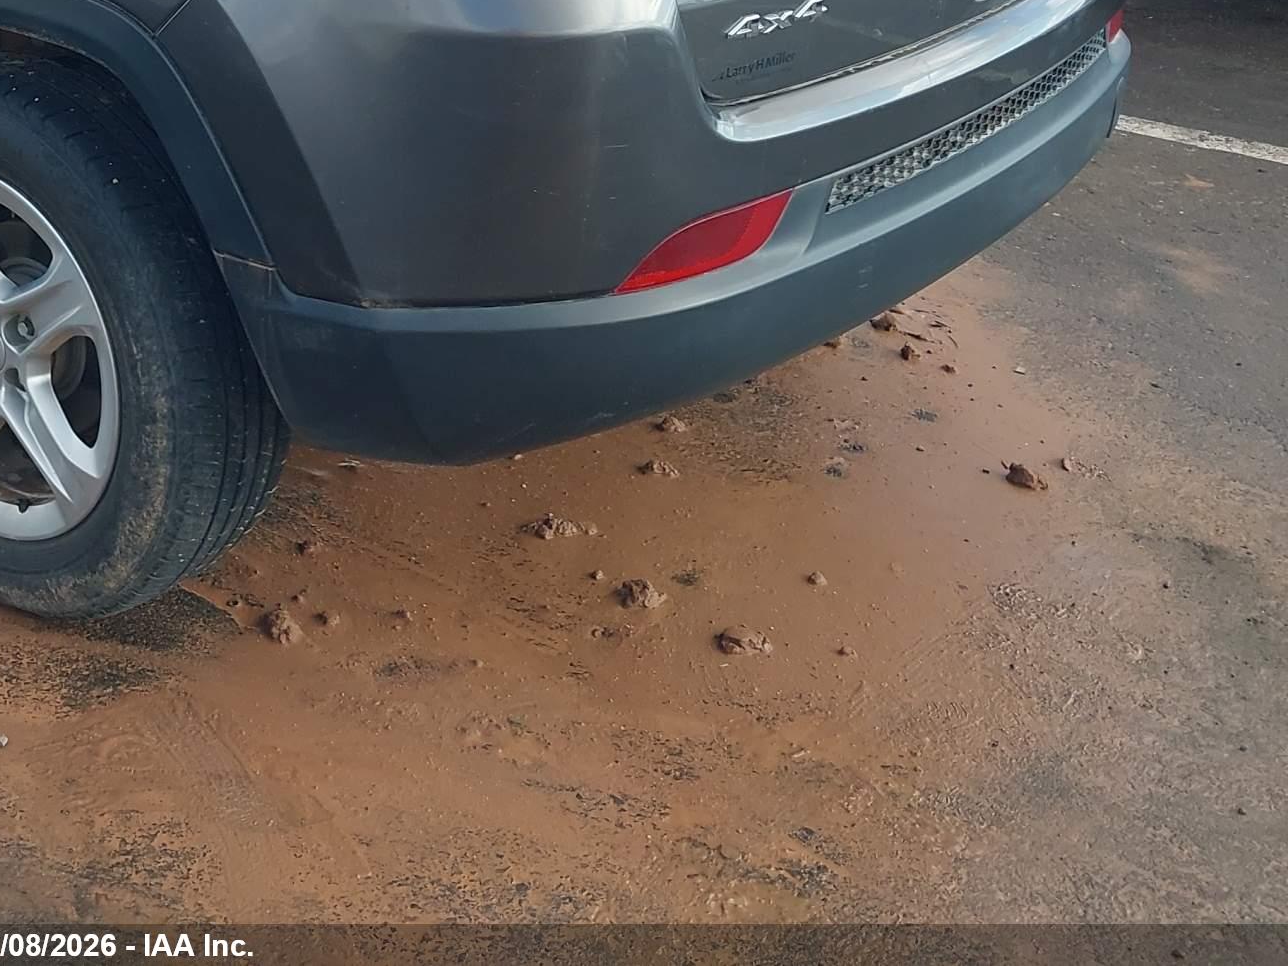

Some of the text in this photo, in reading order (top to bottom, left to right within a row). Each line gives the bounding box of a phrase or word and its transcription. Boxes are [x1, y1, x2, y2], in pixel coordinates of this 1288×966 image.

[726, 62, 755, 79] Larry
[755, 57, 765, 71] H
[765, 50, 796, 69] Miller
